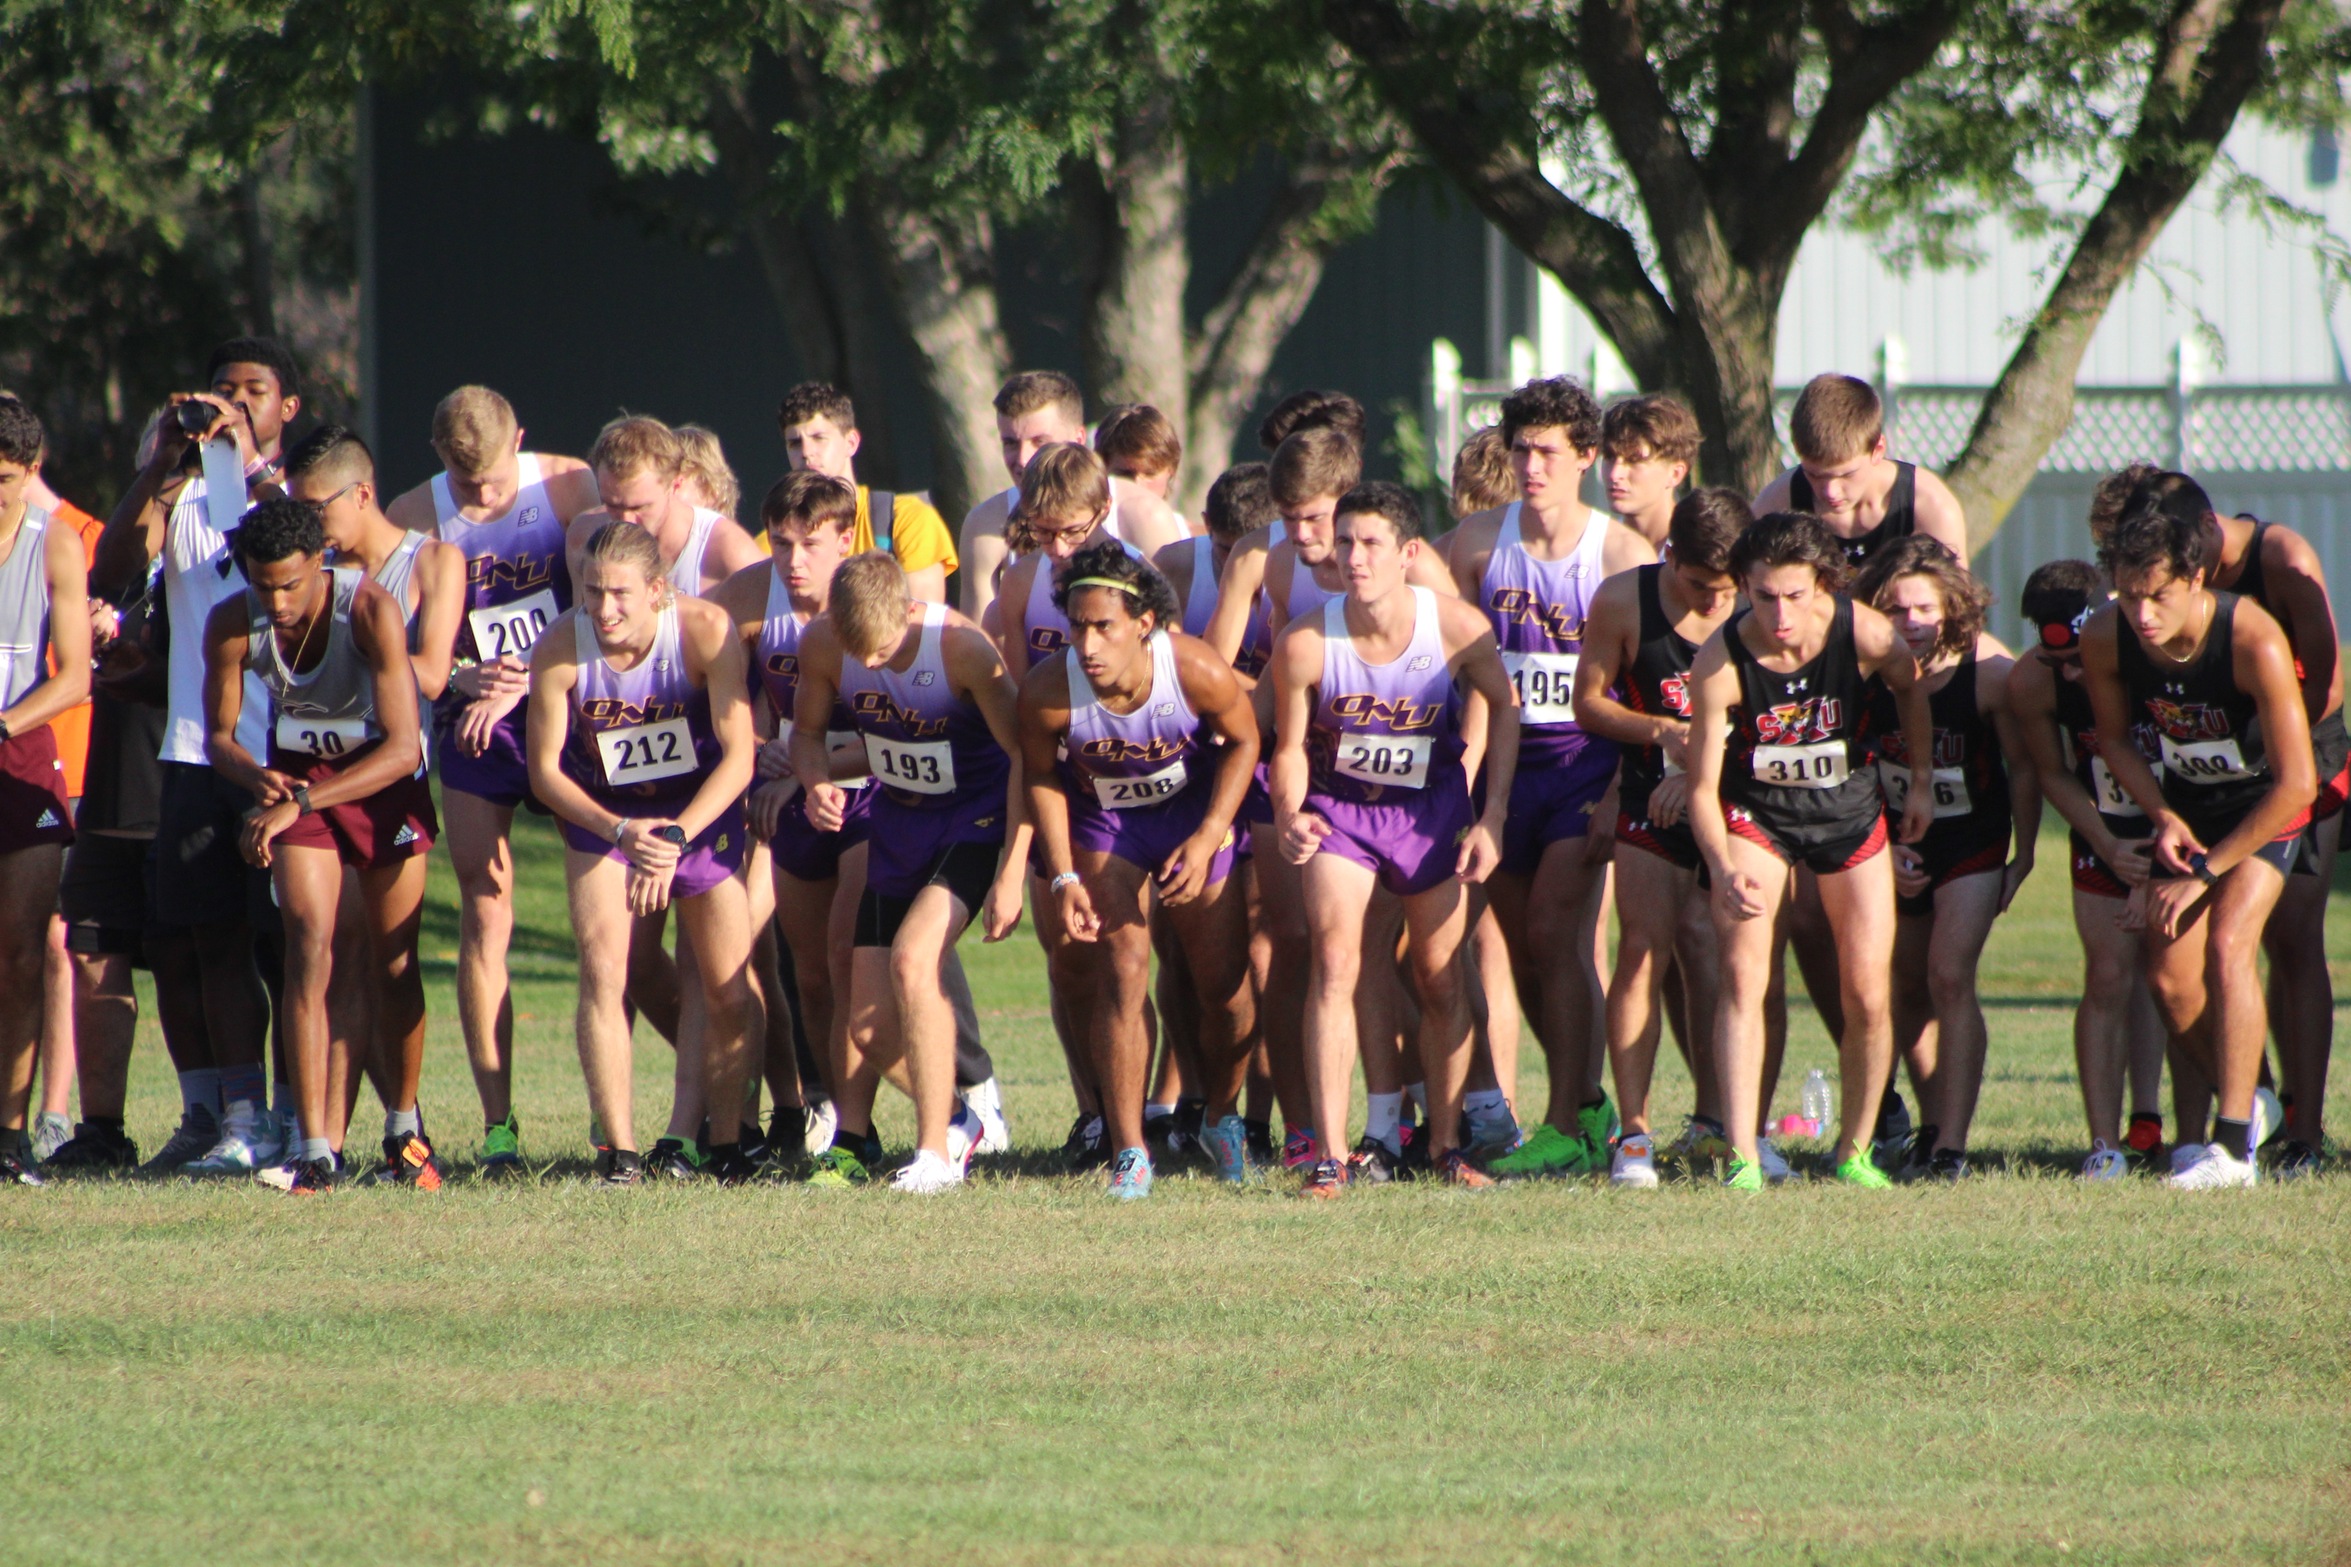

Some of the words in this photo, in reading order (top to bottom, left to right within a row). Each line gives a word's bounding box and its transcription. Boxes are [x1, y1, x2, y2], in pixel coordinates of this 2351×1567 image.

[1490, 587, 1588, 641] ONU
[488, 608, 548, 658] 200
[1512, 669, 1571, 708] 195
[580, 695, 685, 729] ONU
[853, 690, 949, 736] ONU
[1330, 693, 1444, 730] ONU
[300, 730, 344, 756] 30
[614, 731, 682, 770] 212
[1081, 736, 1190, 763] ONU
[881, 749, 941, 784] 193
[1349, 746, 1414, 775] 203
[1769, 756, 1833, 781] 310
[1110, 778, 1175, 801] 208
[1892, 776, 1954, 806] 36
